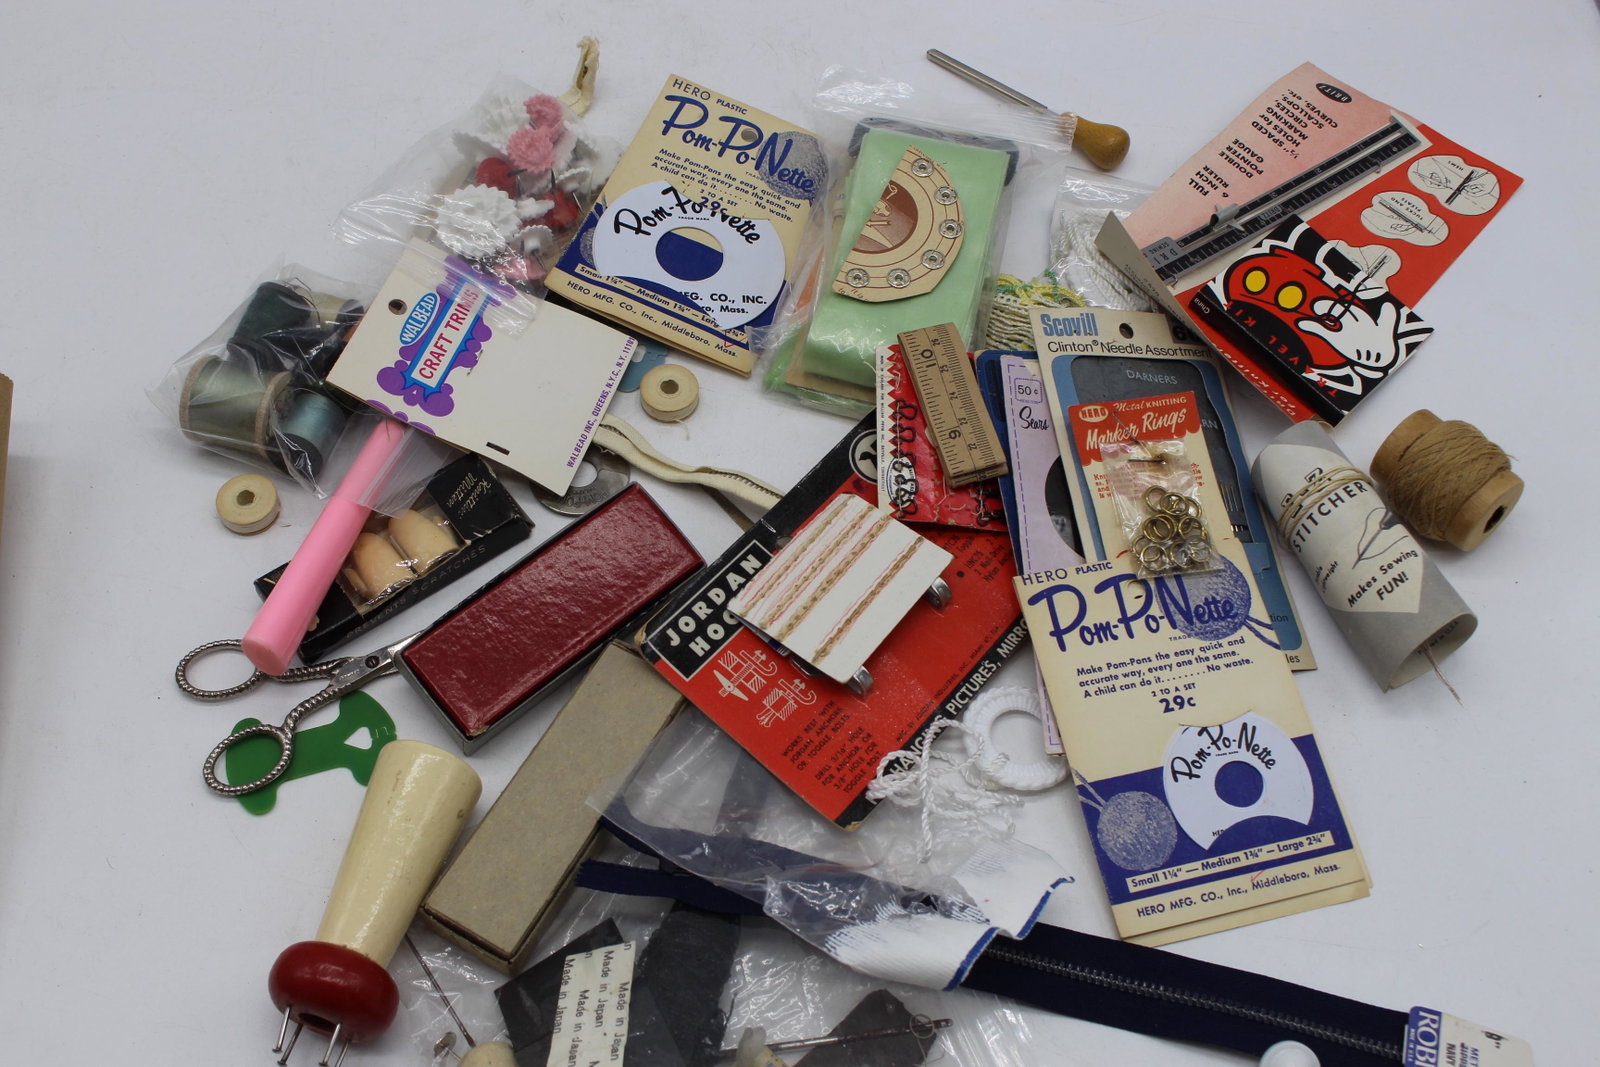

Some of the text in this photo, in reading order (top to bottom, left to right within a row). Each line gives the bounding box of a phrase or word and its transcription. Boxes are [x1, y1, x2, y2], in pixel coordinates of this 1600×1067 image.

[672, 79, 748, 116] HERO PLASTIC
[1270, 98, 1311, 130] CIRCLES,
[1276, 92, 1327, 130] SCALLOPS,
[1284, 87, 1340, 129] CURVES, etc.
[1248, 118, 1286, 148] SPACED
[1256, 112, 1302, 148] HOLES for
[1262, 105, 1310, 141] MARKING
[1215, 149, 1255, 180] DOUBLE
[1222, 143, 1266, 176] POINTER
[1230, 137, 1266, 165] GAUGE
[1446, 159, 1464, 172] HEMS
[650, 160, 793, 222] A child can do No waste.
[653, 152, 788, 213] accurate way, every one the same.
[658, 146, 681, 162] Make
[723, 172, 738, 183] the
[738, 178, 758, 193] easy
[761, 185, 782, 202] quick
[784, 200, 801, 210] and
[1186, 176, 1210, 197] FULL
[1192, 169, 1230, 200] 6 INCH
[1199, 164, 1231, 189] RULER
[706, 190, 717, 199] TO
[725, 198, 738, 208] SET
[1388, 196, 1425, 221] TUCKS AND
[566, 278, 592, 296] HERO
[593, 289, 616, 306] MFG.
[618, 300, 638, 314] CO.,
[640, 309, 659, 323] Inc.,
[636, 286, 671, 307] Medium
[710, 294, 736, 304] CO.,
[742, 294, 767, 304] INC.
[720, 304, 748, 314] Mass.
[1190, 296, 1212, 315] China
[401, 292, 438, 345] WALBEAD
[418, 288, 478, 380] CRAFT TRIMS
[1040, 312, 1098, 338] Scovill
[1101, 341, 1143, 355] Needle
[1145, 344, 1213, 358] Assortment
[1222, 300, 1339, 397] TRAVEL KIT
[1126, 369, 1178, 386] DARNERS
[566, 433, 588, 468] WALBEAD
[591, 388, 610, 417] QUEENS,
[616, 353, 627, 368] N.Y.
[1019, 406, 1050, 430] Sears
[1080, 396, 1187, 420] HERO Metal KNITTING
[1086, 408, 1187, 451] Marker Rings
[1292, 480, 1368, 552] STITCHER
[412, 544, 487, 594] SCRATCHES
[1021, 561, 1112, 586] HERO PLASTIC
[1348, 548, 1419, 608] Makes Sewing
[1376, 570, 1410, 602] FUN!
[666, 554, 763, 647] JORDAN
[688, 605, 743, 658] HOO
[1270, 613, 1288, 623] tion
[946, 659, 1002, 714] PICTURES,
[996, 620, 1032, 658] MIRRO
[1076, 635, 1246, 676] Make Pom-Pons the easy quick and
[1078, 648, 1239, 688] accurate way, every one the same.
[1286, 653, 1300, 664] les
[1083, 654, 1254, 698] A child can do No waste.
[1159, 686, 1171, 696] TO
[1173, 685, 1181, 693] A
[1182, 681, 1196, 691] SET
[1132, 839, 1305, 888] Small Medium Large
[1135, 902, 1166, 918] HERO
[1168, 894, 1197, 910] MFG.
[1199, 888, 1223, 903] CO.,
[1225, 882, 1248, 897] Inc.,
[1314, 863, 1341, 876] Mass.
[560, 958, 576, 986] Made
[594, 950, 614, 1028] Made in Japan
[558, 991, 567, 1000] in
[568, 990, 590, 1067] Made in Japan
[610, 980, 630, 1060] Made in Japan
[1446, 1043, 1456, 1066] NAVY
